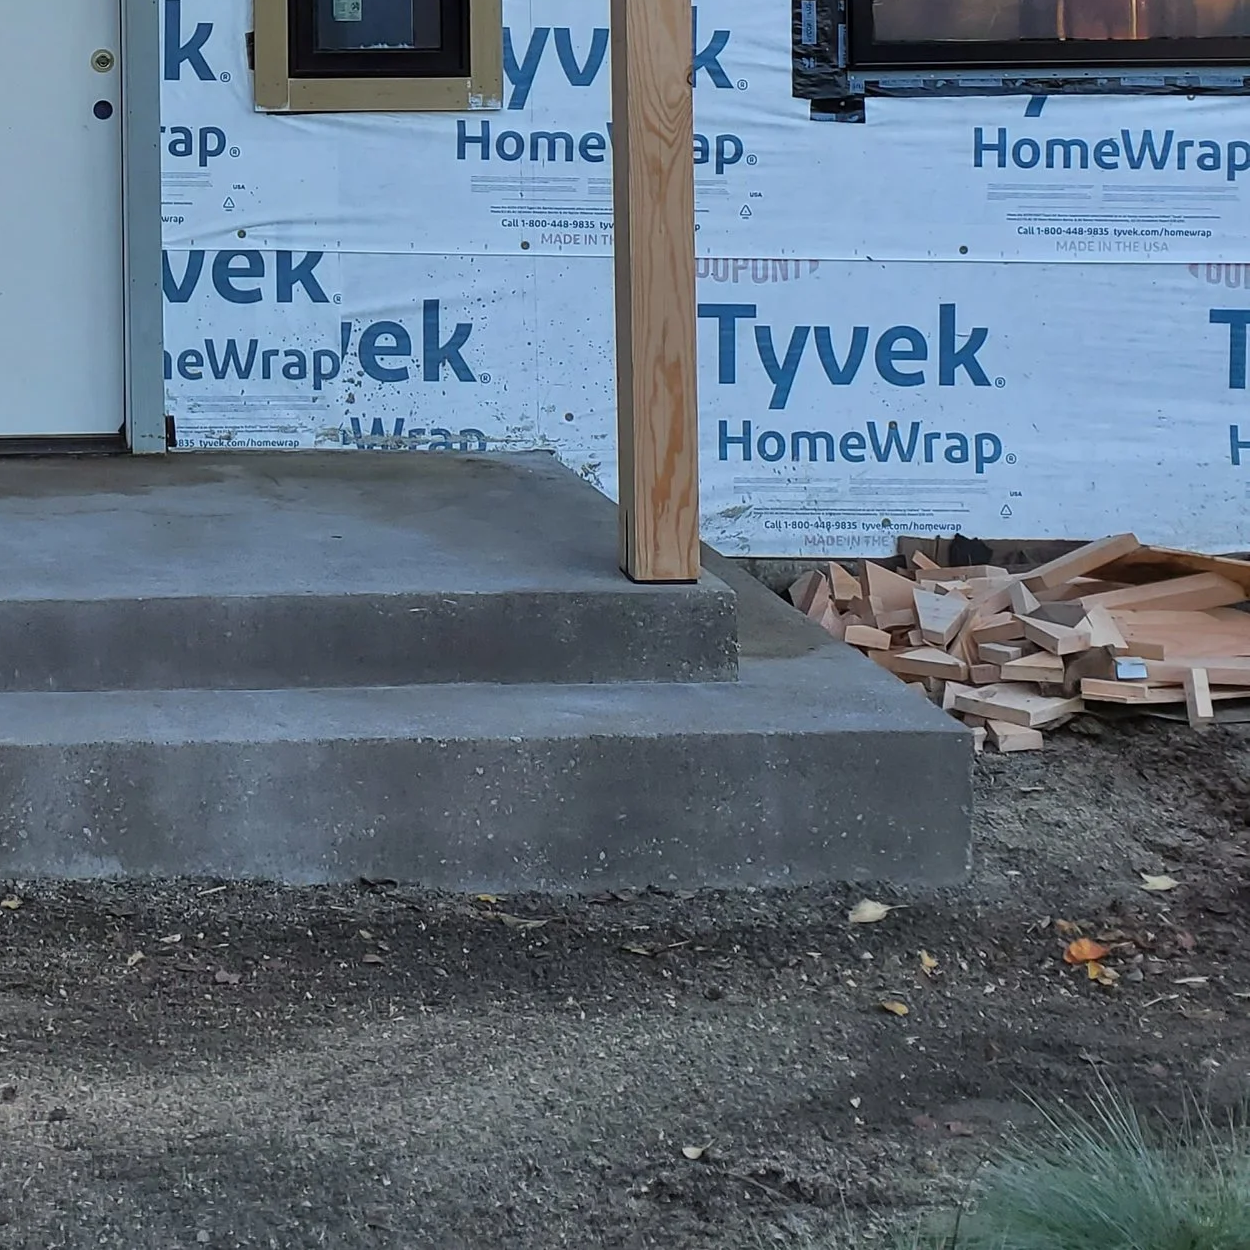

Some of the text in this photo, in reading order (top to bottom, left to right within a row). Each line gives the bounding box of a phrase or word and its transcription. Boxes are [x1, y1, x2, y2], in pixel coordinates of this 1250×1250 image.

[973, 127, 1250, 181] HomeWrap
[501, 218, 519, 228] Call
[522, 218, 595, 229] 1-800-448-9835
[541, 232, 580, 245] MADE
[584, 234, 597, 245] IN
[1017, 226, 1212, 238] Call 1-800-448-9835 tyvek.com/homewrap
[1056, 240, 1169, 253] MADE IN THE USA
[697, 303, 992, 410] Tyvek
[199, 438, 300, 448] tyvek.com/homewrap
[718, 420, 1003, 474] HomeWrap
[764, 520, 782, 530] Call
[784, 521, 857, 530] 1-800-448-9835
[804, 534, 844, 547] MADE
[864, 535, 888, 547] THE
